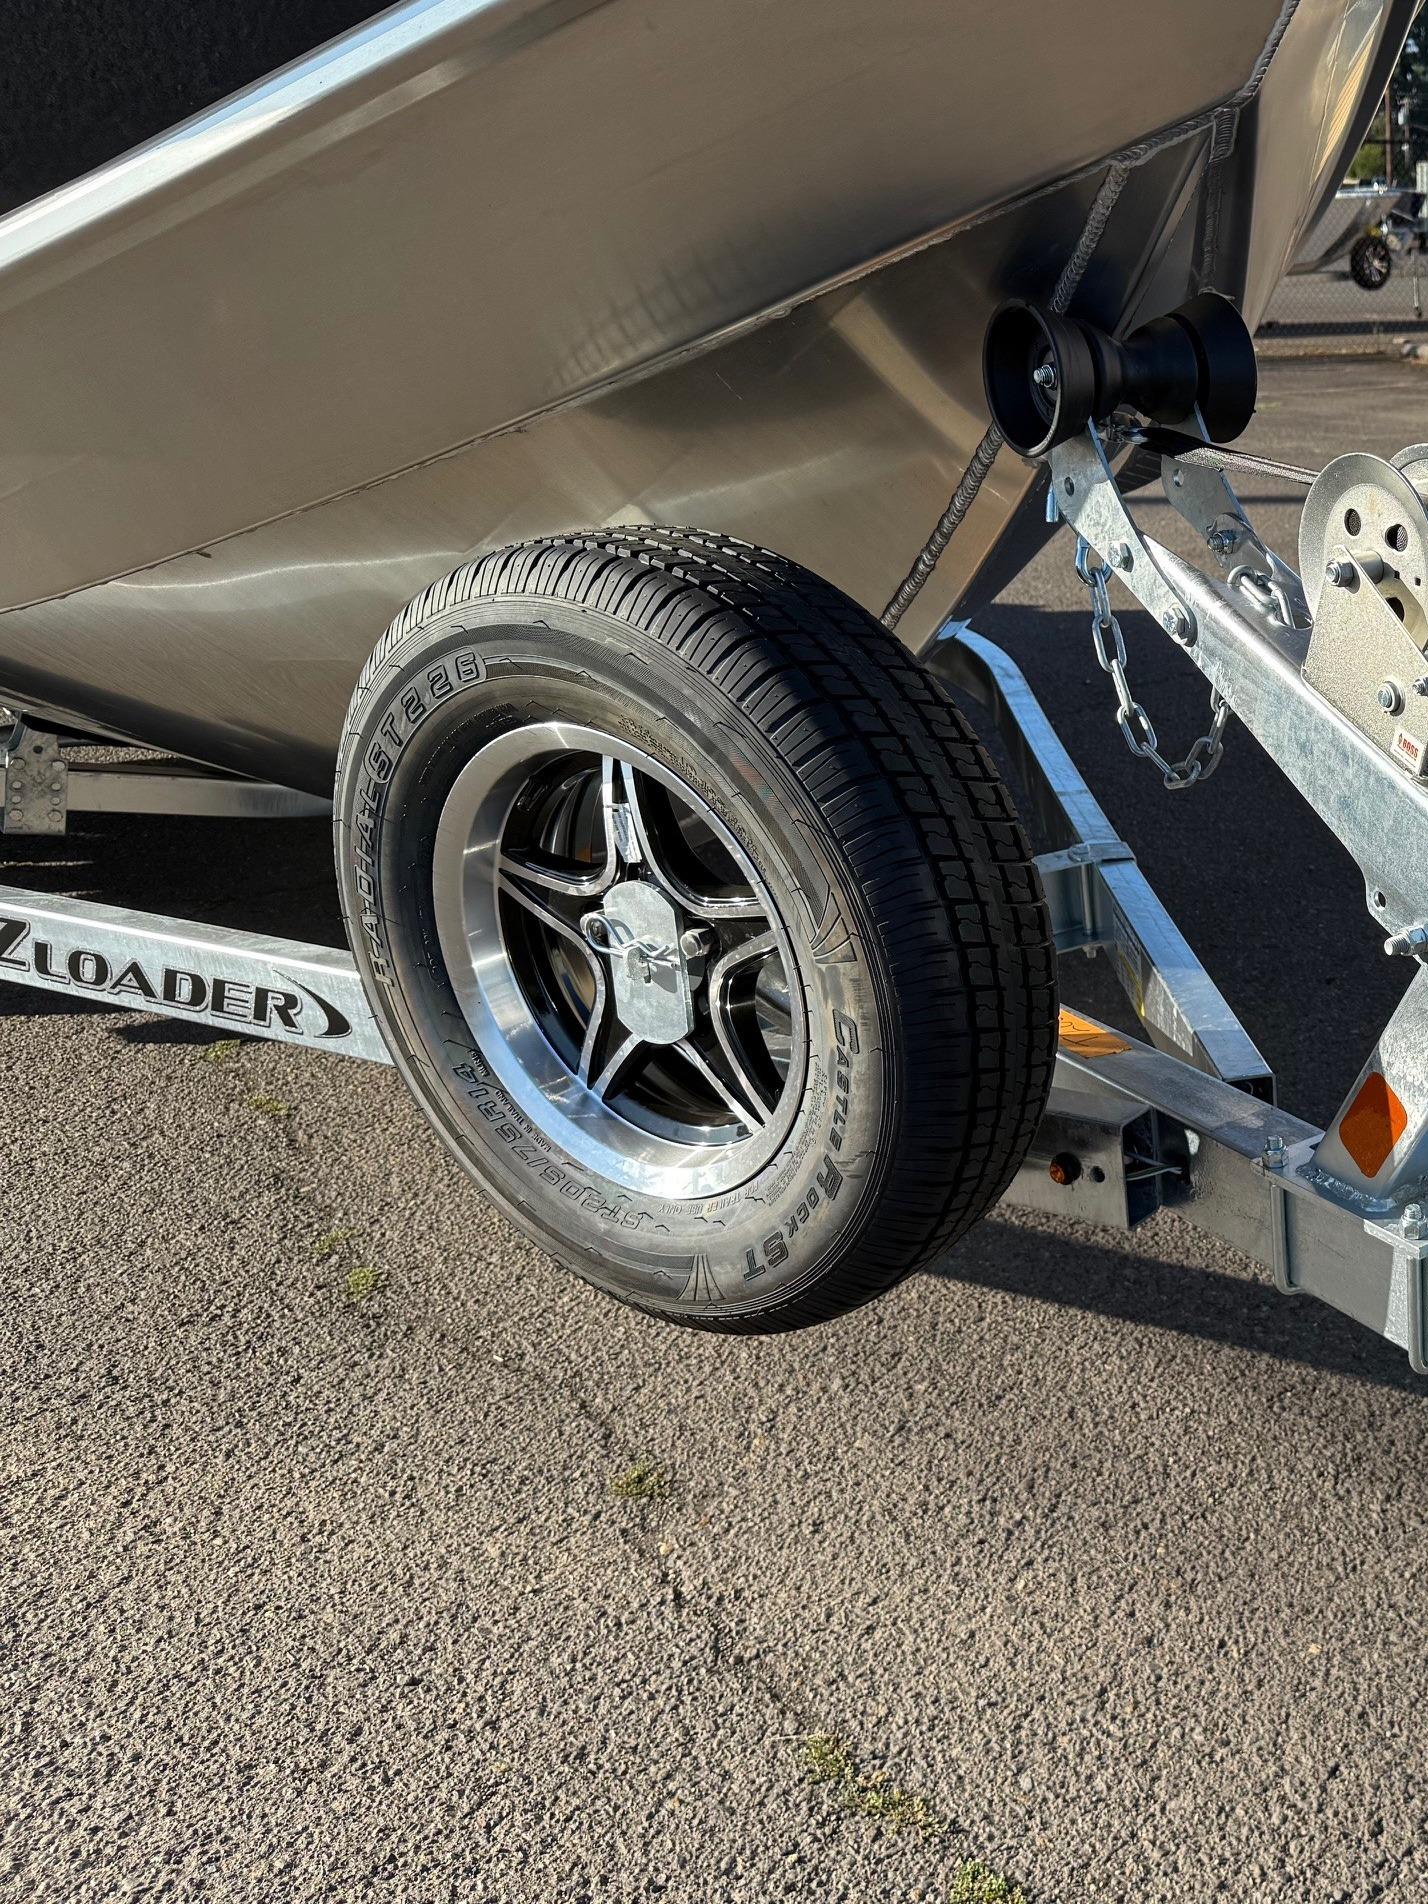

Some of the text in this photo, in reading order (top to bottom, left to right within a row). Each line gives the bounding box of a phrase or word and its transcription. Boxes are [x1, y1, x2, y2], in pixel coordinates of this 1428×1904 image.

[366, 649, 482, 783] ST226
[354, 778, 396, 988] RADIAL
[452, 1061, 642, 1231] ST205/75R14
